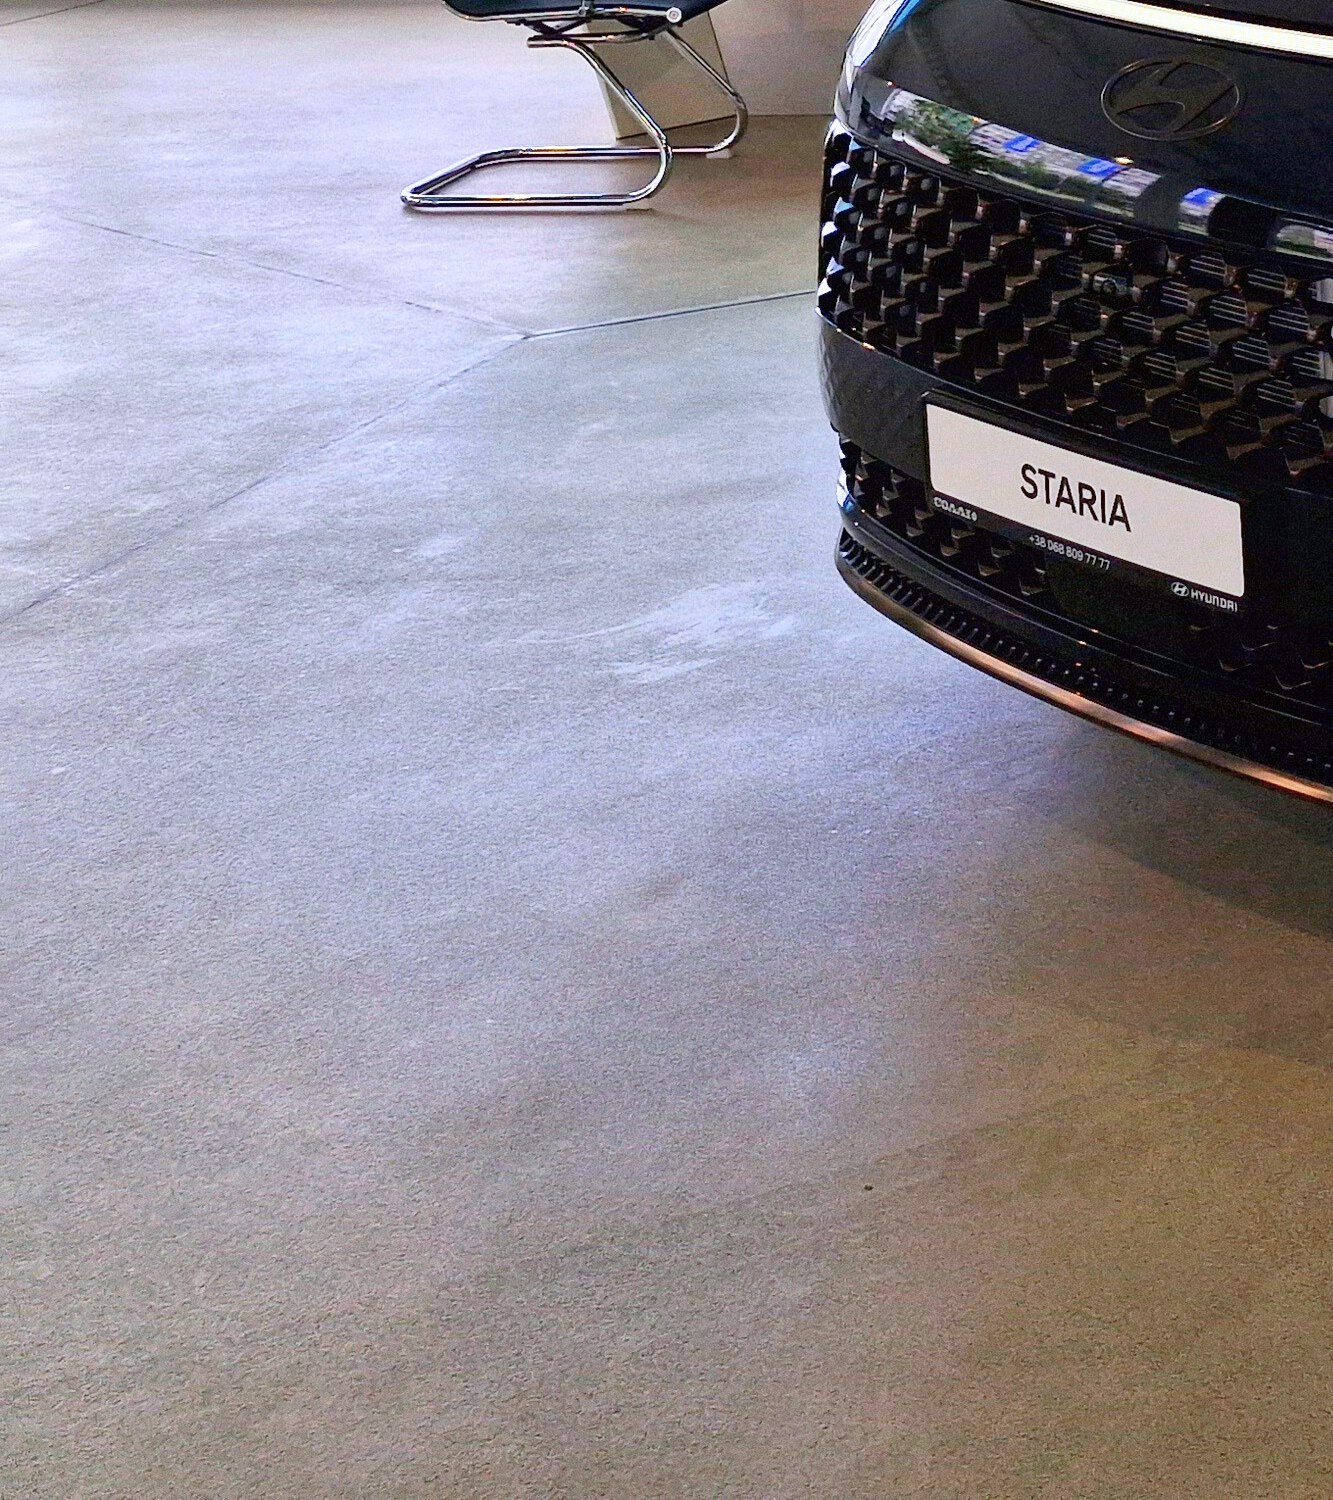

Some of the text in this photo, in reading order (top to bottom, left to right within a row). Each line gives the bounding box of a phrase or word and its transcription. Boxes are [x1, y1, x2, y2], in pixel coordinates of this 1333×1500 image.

[1019, 463, 1132, 533] STARIA
[1029, 534, 1047, 548] +38
[1065, 545, 1084, 562] 809
[1084, 552, 1097, 566] 77
[1097, 557, 1111, 571] 77
[1190, 588, 1238, 613] HYUNDAI
